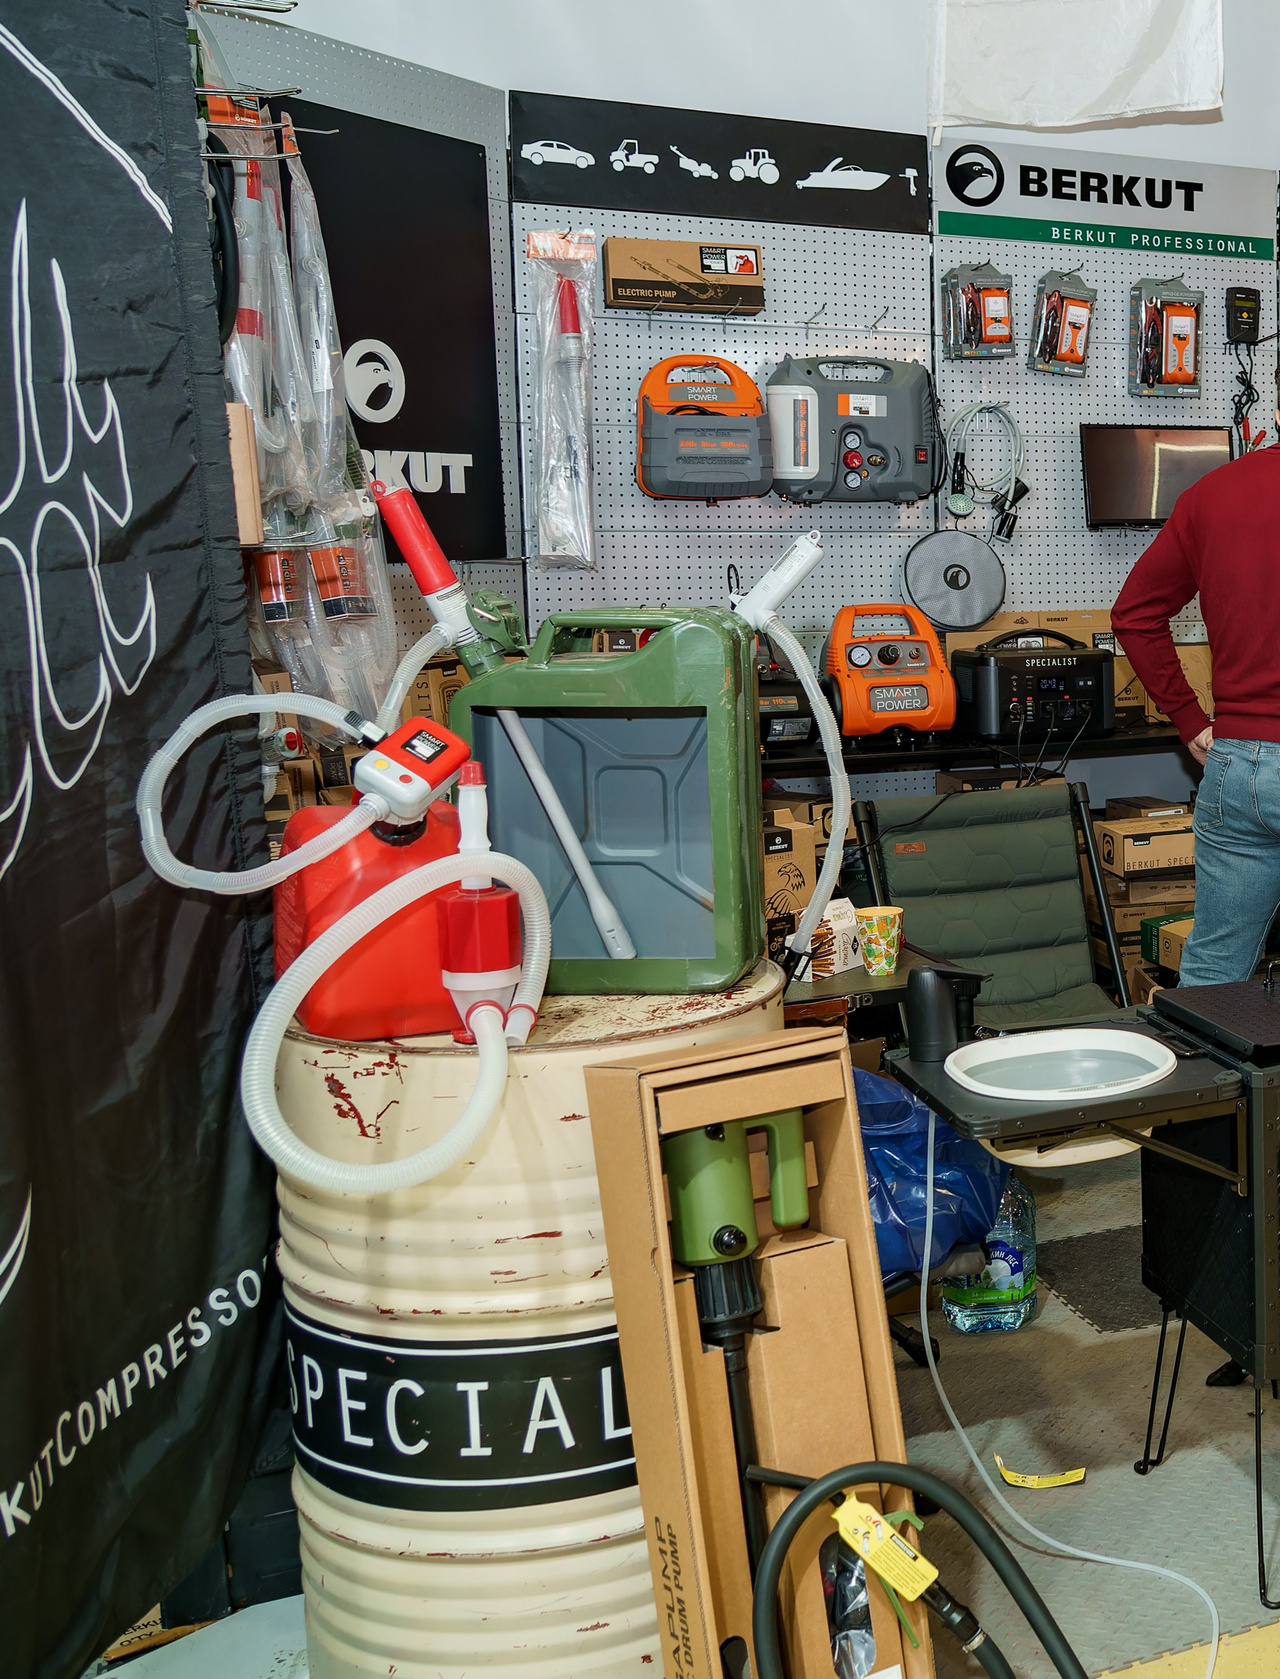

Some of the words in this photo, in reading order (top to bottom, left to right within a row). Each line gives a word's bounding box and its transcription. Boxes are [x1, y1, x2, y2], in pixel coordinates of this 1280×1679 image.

[1019, 164, 1204, 212] BERKUT
[1051, 227, 1117, 244] BERKUT
[1131, 233, 1257, 254] PROFESSIONAL
[617, 287, 653, 297] ELECTRIC
[654, 289, 677, 299] PUMP
[687, 386, 717, 394] SMART
[688, 393, 719, 401] POWER
[1025, 657, 1078, 668] SPECIALIST
[874, 686, 919, 699] SMART
[876, 699, 921, 712] POWER
[420, 731, 446, 747] SMART
[1126, 859, 1161, 871] BERKUT
[286, 1338, 633, 1457] SPECIAL
[665, 1523, 685, 1592] PUMP
[675, 1596, 694, 1668] DRUM
